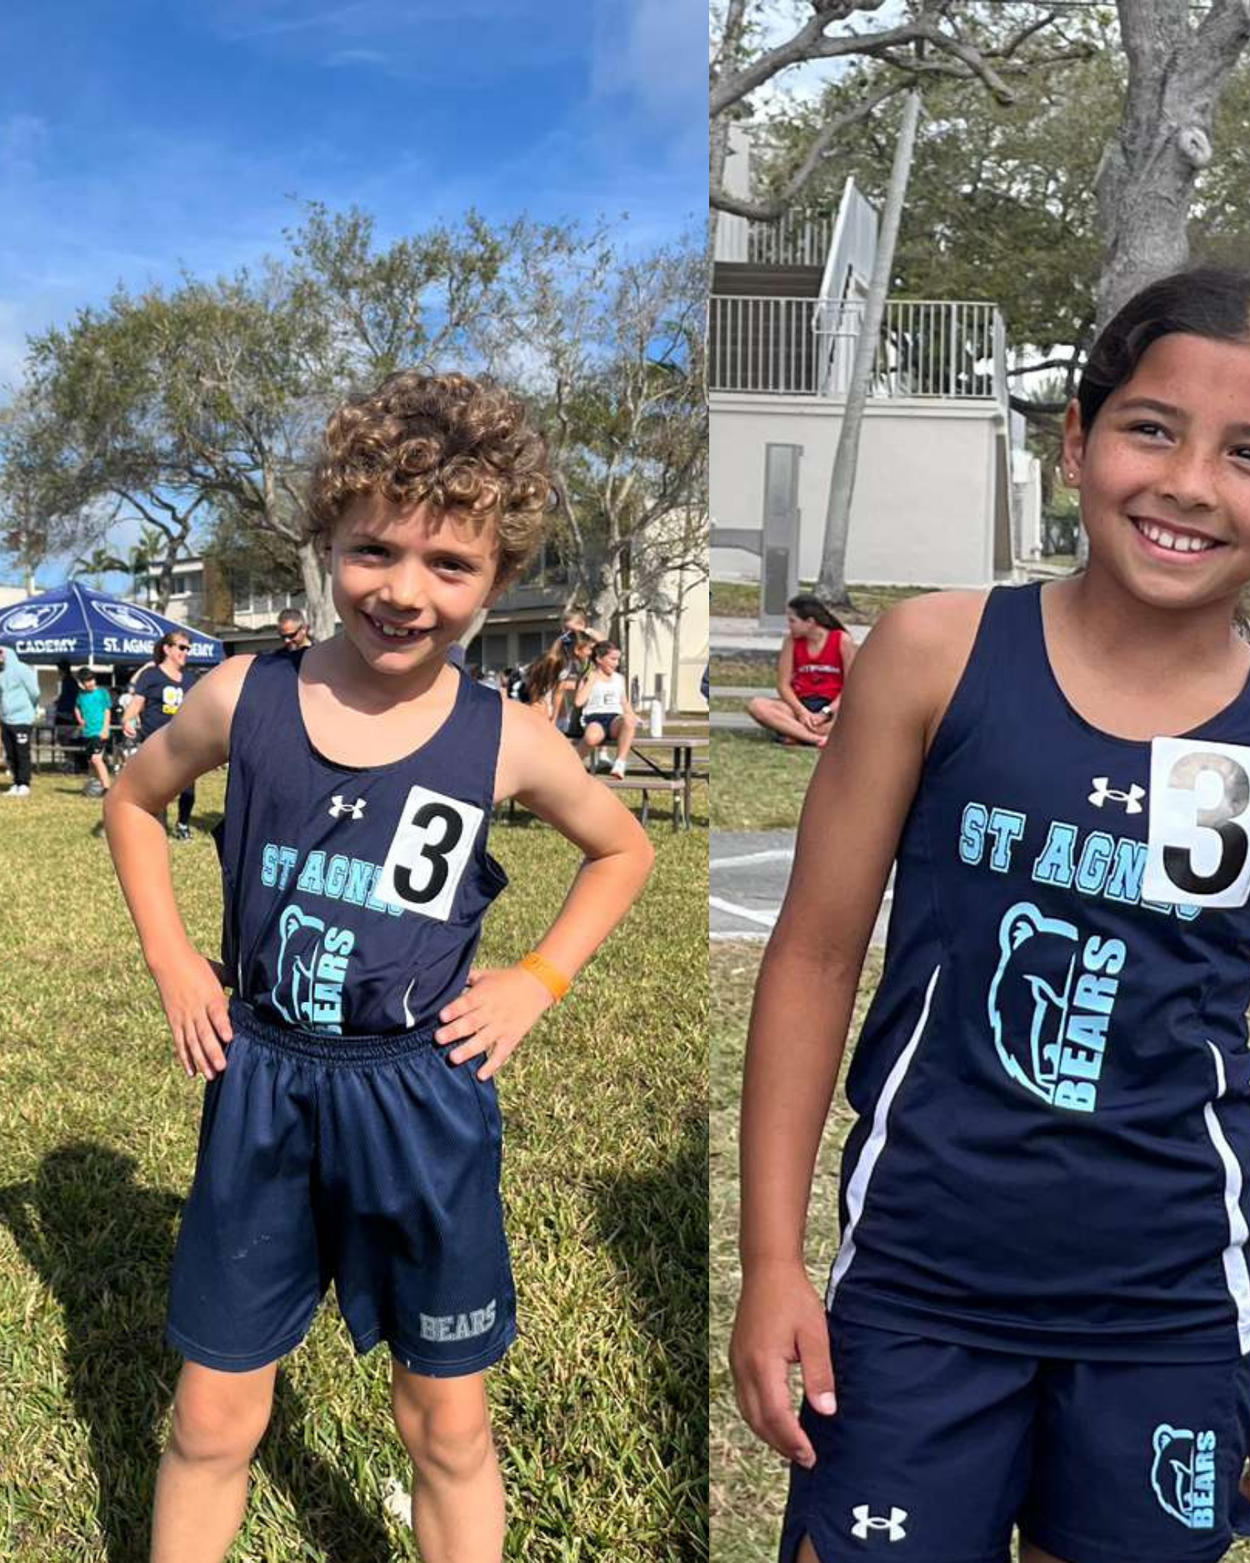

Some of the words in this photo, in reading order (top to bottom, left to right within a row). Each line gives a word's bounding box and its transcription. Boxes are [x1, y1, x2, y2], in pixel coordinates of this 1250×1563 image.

[123, 638, 154, 654] AGNE
[392, 802, 464, 904] 3
[958, 800, 1027, 874] ST
[1031, 820, 1203, 921] AGN
[1162, 751, 1250, 896] 3
[261, 842, 299, 891] ST
[296, 849, 405, 917] AGN
[1052, 934, 1128, 1113] BEARS
[419, 1298, 497, 1342] BEARS
[1192, 1430, 1216, 1529] BEARS
